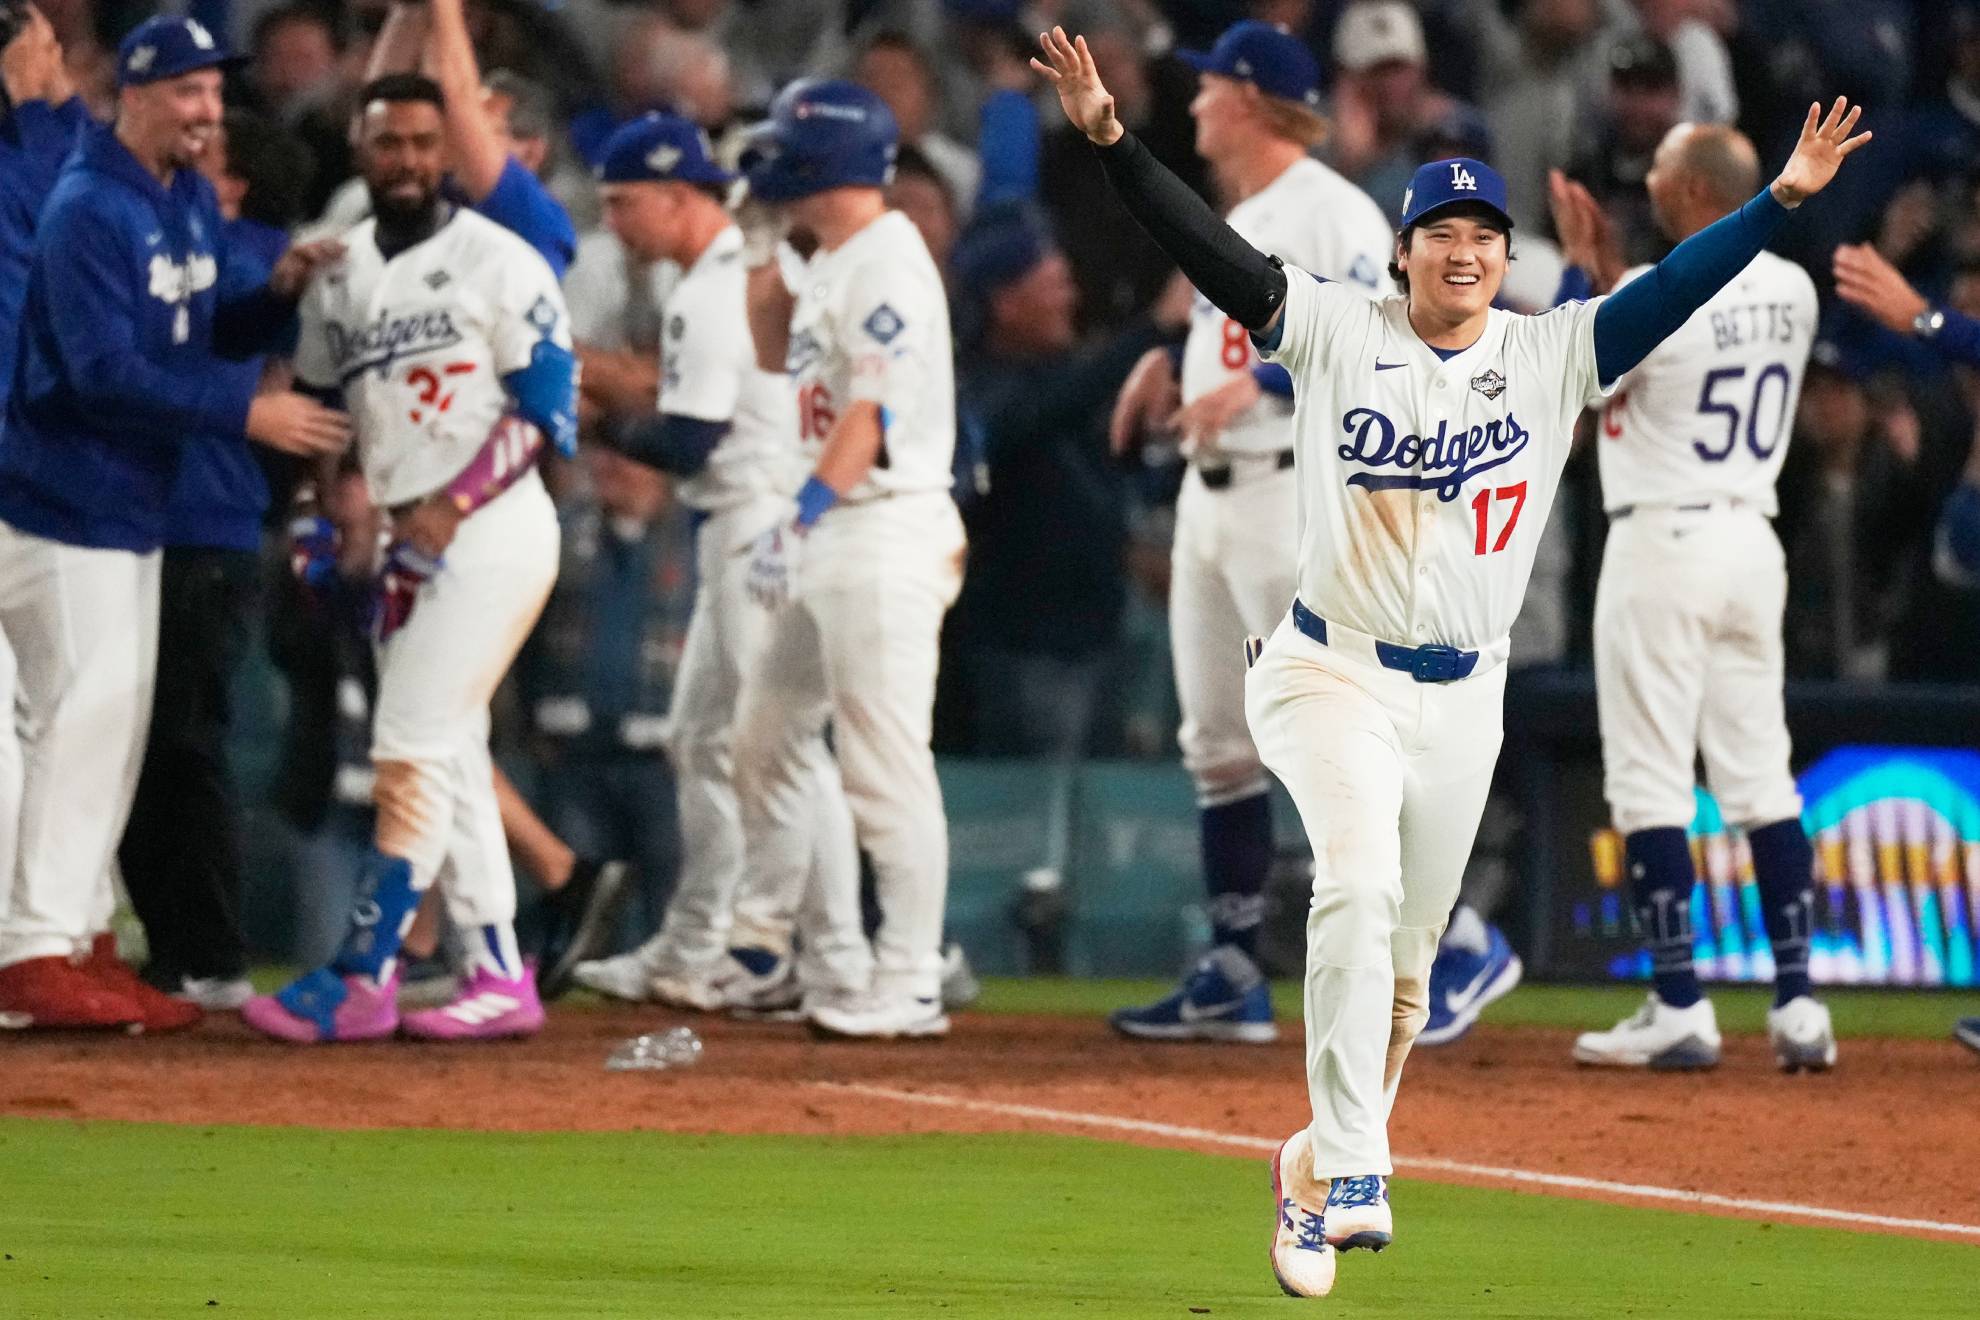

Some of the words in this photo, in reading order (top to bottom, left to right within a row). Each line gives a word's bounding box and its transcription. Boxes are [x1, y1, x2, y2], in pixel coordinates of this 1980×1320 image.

[1450, 163, 1477, 190] LA
[1711, 303, 1793, 350] BETTS
[798, 384, 835, 441] 16
[1694, 363, 1789, 462] 50
[1338, 408, 1529, 502] Dodgers
[1471, 480, 1527, 556] 17
